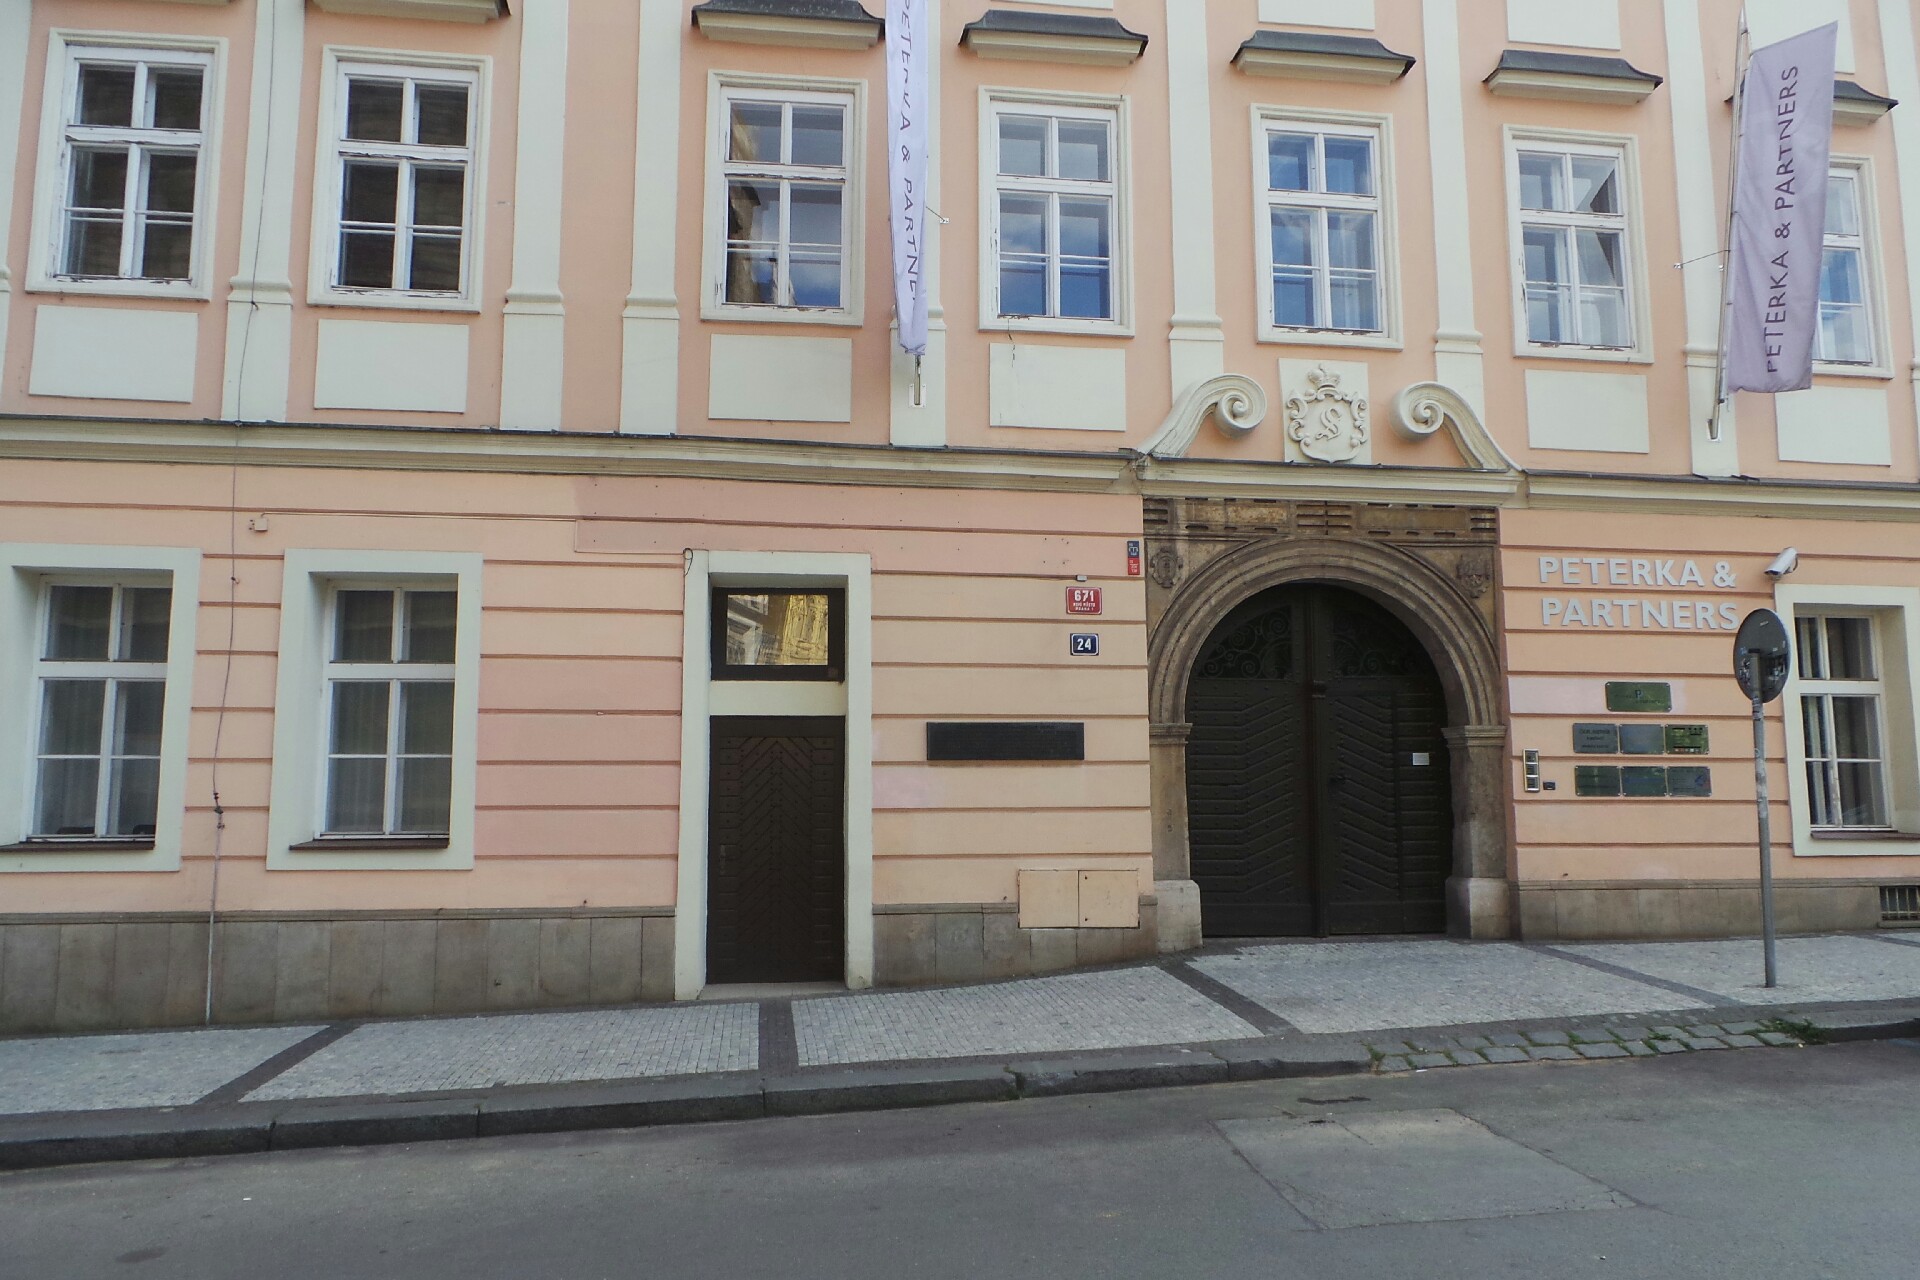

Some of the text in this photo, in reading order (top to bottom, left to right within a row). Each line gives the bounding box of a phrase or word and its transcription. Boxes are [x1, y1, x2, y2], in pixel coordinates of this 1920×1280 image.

[901, 144, 912, 163] &
[1763, 65, 1800, 374] PETERKA & PARTNERS
[903, 177, 919, 301] PARTNE
[1538, 556, 1737, 589] PETERKA &
[1074, 589, 1094, 602] 671
[1541, 597, 1740, 630] PARTNERS
[1076, 637, 1092, 651] 24
